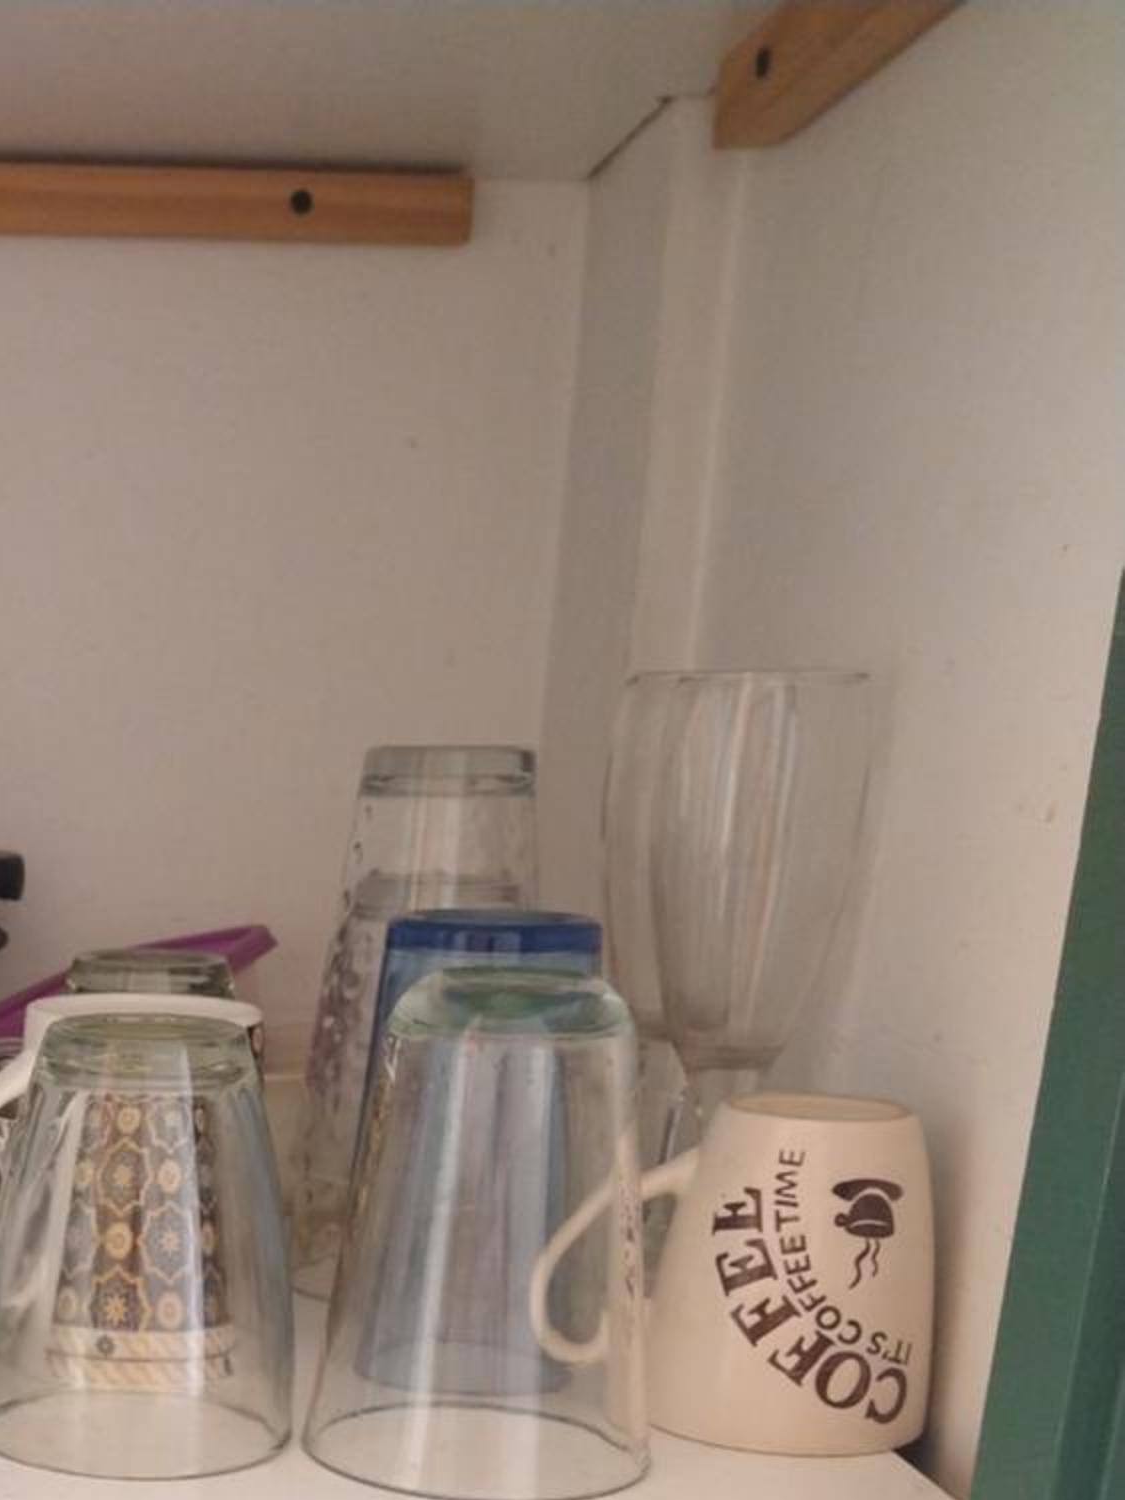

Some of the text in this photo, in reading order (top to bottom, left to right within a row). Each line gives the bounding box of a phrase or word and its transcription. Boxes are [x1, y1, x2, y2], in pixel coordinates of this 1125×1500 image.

[774, 1149, 805, 1232] TIME
[712, 1187, 908, 1424] COFFEE
[779, 1234, 863, 1345] COFFEE
